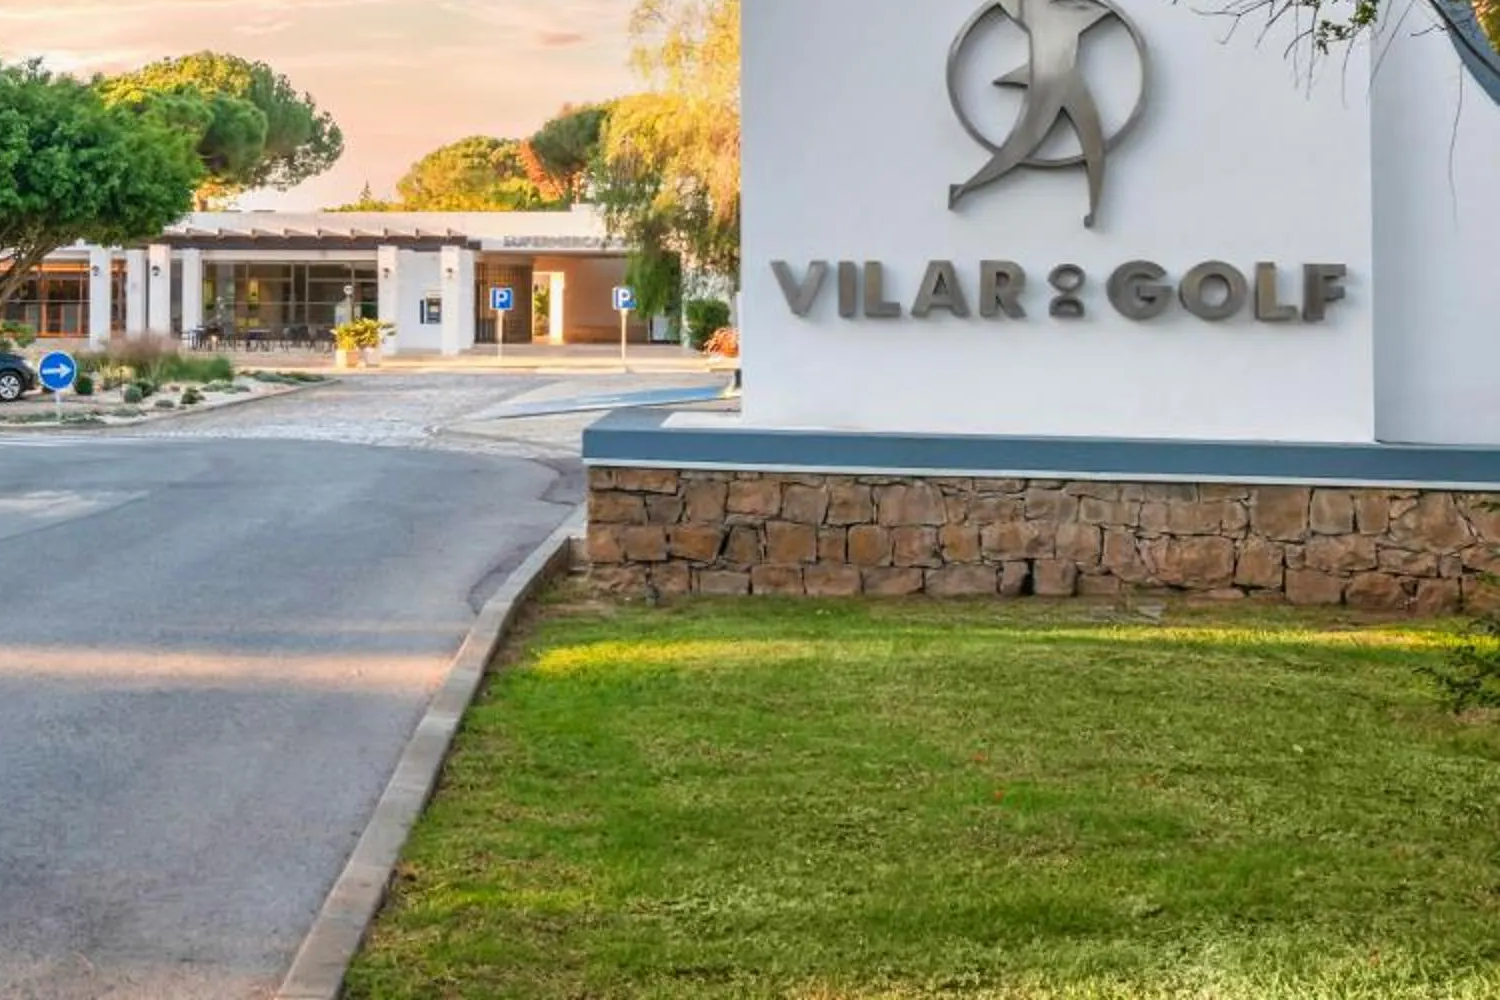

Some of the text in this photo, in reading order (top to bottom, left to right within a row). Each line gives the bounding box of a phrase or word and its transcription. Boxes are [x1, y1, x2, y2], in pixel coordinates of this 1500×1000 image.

[495, 289, 509, 308] P
[769, 259, 1028, 319] VILAR
[1106, 259, 1347, 321] GOLF
